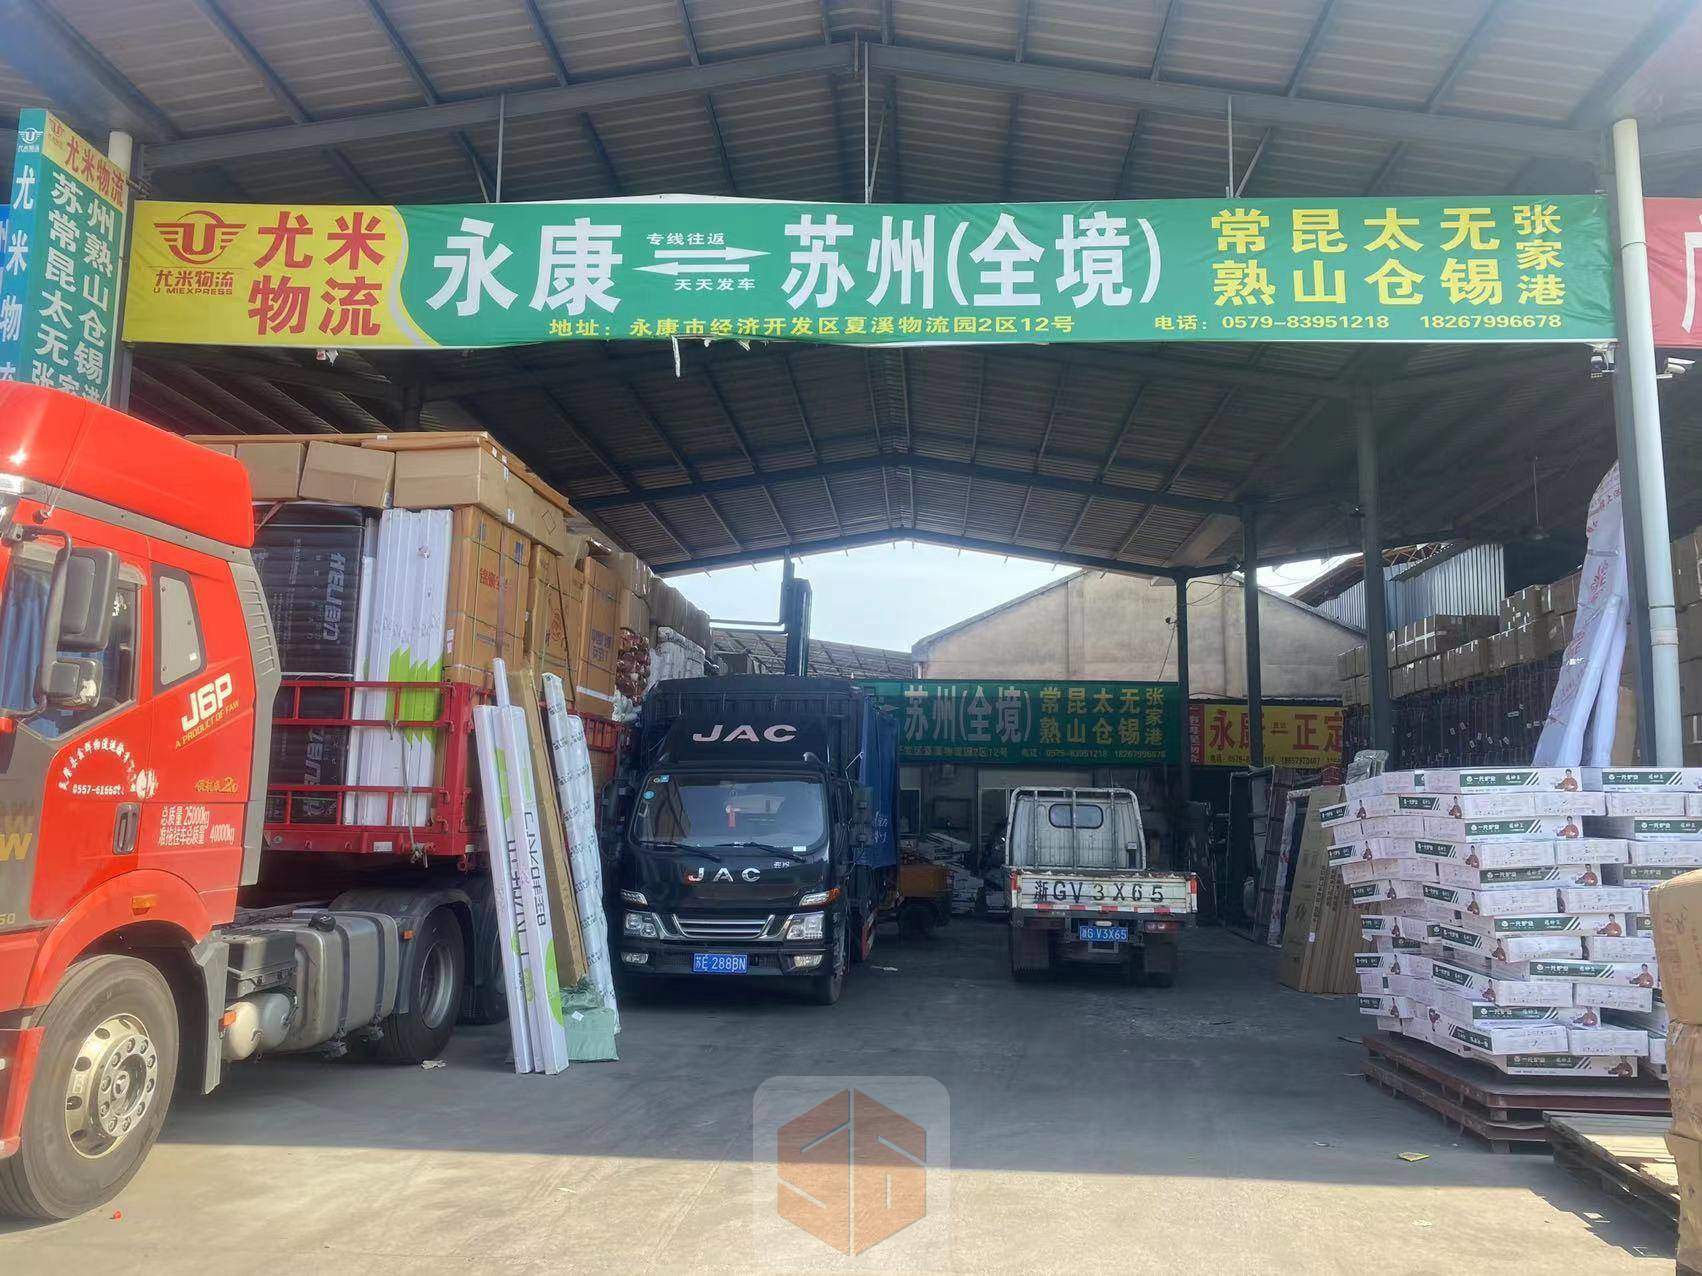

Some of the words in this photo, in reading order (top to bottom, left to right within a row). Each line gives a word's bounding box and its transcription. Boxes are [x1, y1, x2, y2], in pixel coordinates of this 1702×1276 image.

[65, 136, 125, 208] 尤米物流
[51, 171, 115, 241] 苏州
[48, 209, 113, 278] 常熟
[254, 211, 386, 270] 尤米
[426, 217, 623, 317] 永康
[646, 232, 727, 247] 专线往返
[780, 211, 1162, 310] 苏州(全境)
[1211, 208, 1276, 307] 常熟
[1292, 208, 1348, 305] 昆山
[1363, 207, 1426, 306] 太仓
[1439, 207, 1504, 306] 无锡
[1512, 203, 1567, 306] 张家港
[45, 245, 109, 312] 昆山
[155, 269, 235, 288] 尤米物流
[248, 275, 383, 336] 物流
[673, 278, 756, 292] 天天发车
[39, 289, 107, 348] 太仓
[1221, 314, 1390, 329] 0579-83951218
[1420, 313, 1563, 329] 18267996678
[34, 323, 104, 384] 无锡
[181, 673, 233, 733] J6P
[692, 724, 798, 742] JAC
[904, 685, 1032, 743] 苏州(全境)
[688, 867, 761, 882] JAC
